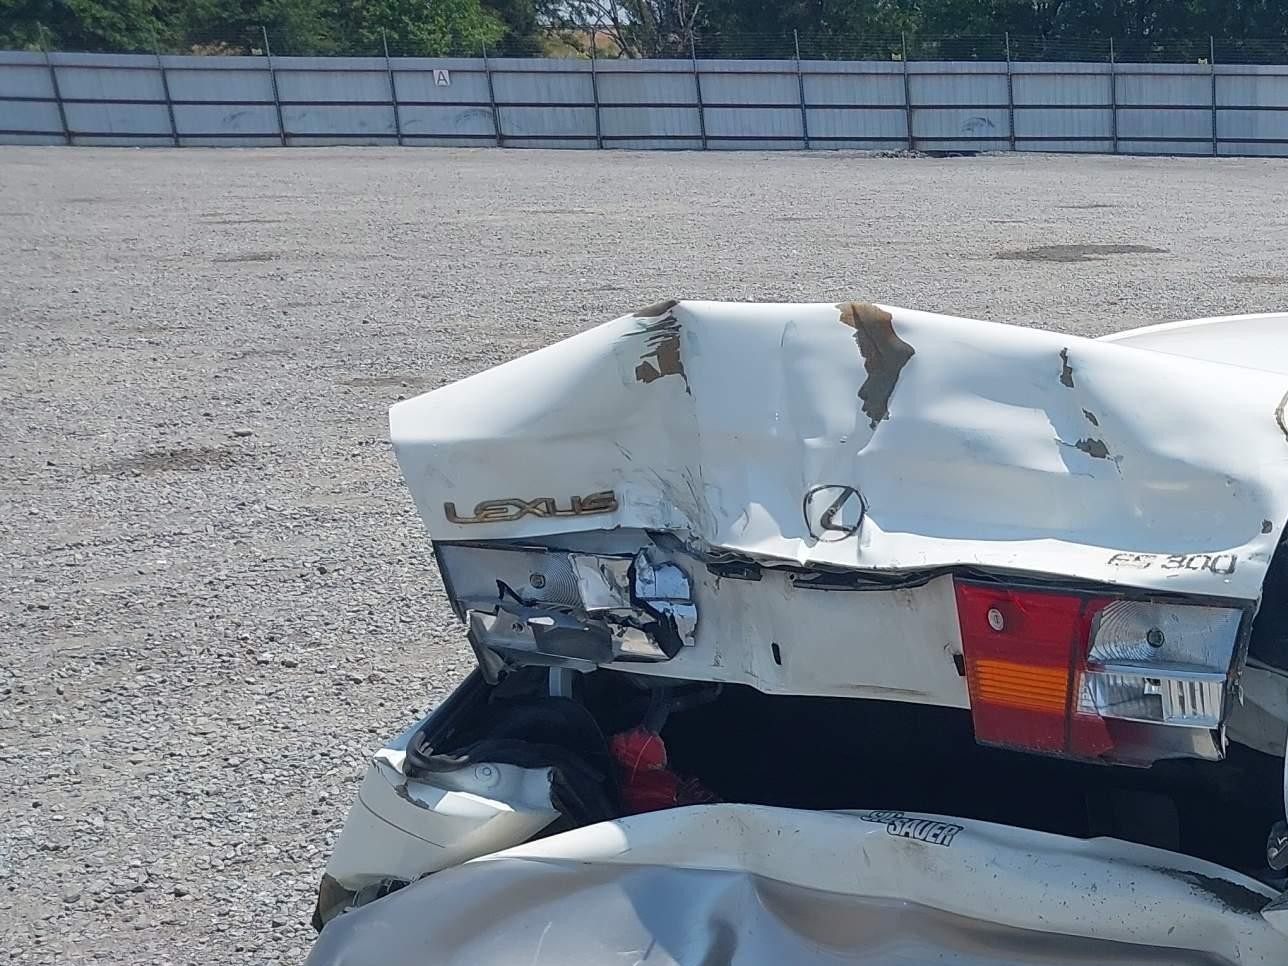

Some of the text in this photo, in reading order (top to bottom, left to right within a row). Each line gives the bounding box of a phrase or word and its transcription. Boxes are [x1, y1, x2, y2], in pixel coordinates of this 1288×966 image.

[444, 490, 619, 523] LEXUS
[1161, 554, 1237, 575] 300
[887, 819, 964, 847] SAUER
